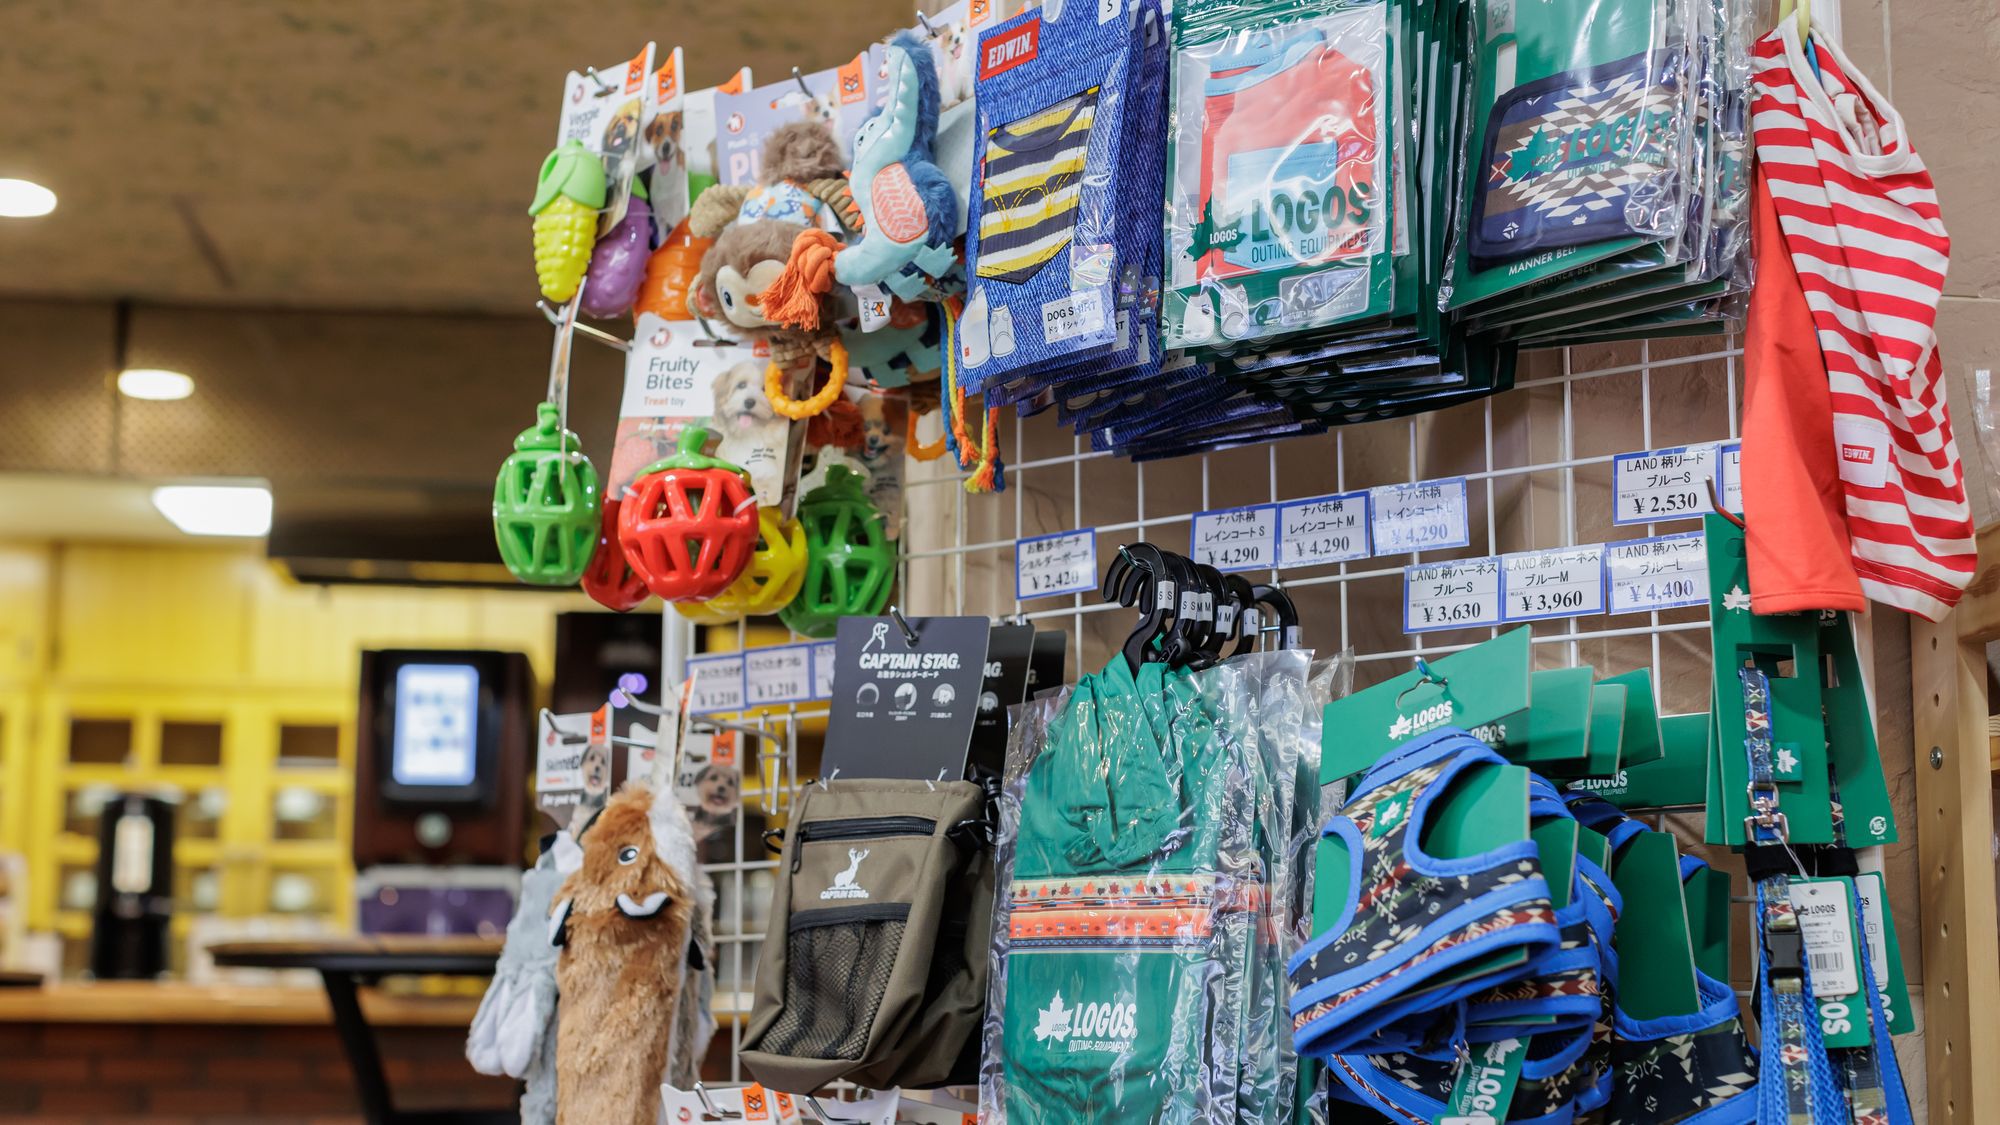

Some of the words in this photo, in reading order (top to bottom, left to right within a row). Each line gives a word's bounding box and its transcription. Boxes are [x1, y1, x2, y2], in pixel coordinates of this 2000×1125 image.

[987, 32, 1032, 69] EDWIN
[1252, 182, 1371, 242] LOGOS
[1209, 229, 1238, 245] LOGOS
[1508, 252, 1552, 276] MANNER
[1047, 309, 1066, 322] DOG
[649, 356, 700, 375] Fruity
[646, 374, 695, 390] Bites
[1626, 458, 1657, 472] LAND
[1661, 452, 1705, 468] 柄リード
[1647, 471, 1691, 488] ブルーS
[1301, 501, 1343, 517] ナバホ柄
[1650, 492, 1697, 515] 2,530
[1216, 511, 1256, 526] ナバホ柄
[1290, 517, 1343, 534] レインコート
[1346, 515, 1355, 527] M
[1205, 527, 1256, 542] レインコート
[1258, 525, 1265, 537] S
[1406, 523, 1448, 545] 4,290
[1309, 536, 1350, 556] 4,290
[1618, 544, 1649, 559] LAND
[1652, 537, 1703, 556] 柄ハーネ
[1220, 546, 1259, 566] 4,290
[1507, 556, 1536, 571] LAND
[1540, 551, 1599, 568] 柄ハーネス
[1410, 568, 1438, 582] LAND
[1441, 563, 1497, 579] 柄ハーネス
[1640, 558, 1683, 575] ブルーL
[1044, 570, 1079, 589] 2,420
[1525, 570, 1569, 587] ブルーM
[1433, 581, 1473, 597] ブルーS
[1646, 580, 1694, 602] 4,400
[1537, 590, 1583, 613] 3,960
[1438, 602, 1481, 624] 3,630
[859, 653, 923, 670] CAPTAIN
[921, 653, 958, 670] STAG
[1413, 700, 1453, 729] LOGOS
[1471, 725, 1506, 742] OGOS
[1811, 904, 1836, 914] LOGOS
[1051, 1023, 1067, 1032] LOGOS
[1072, 1002, 1137, 1038] LOGOS
[1471, 1067, 1506, 1117] LOG
